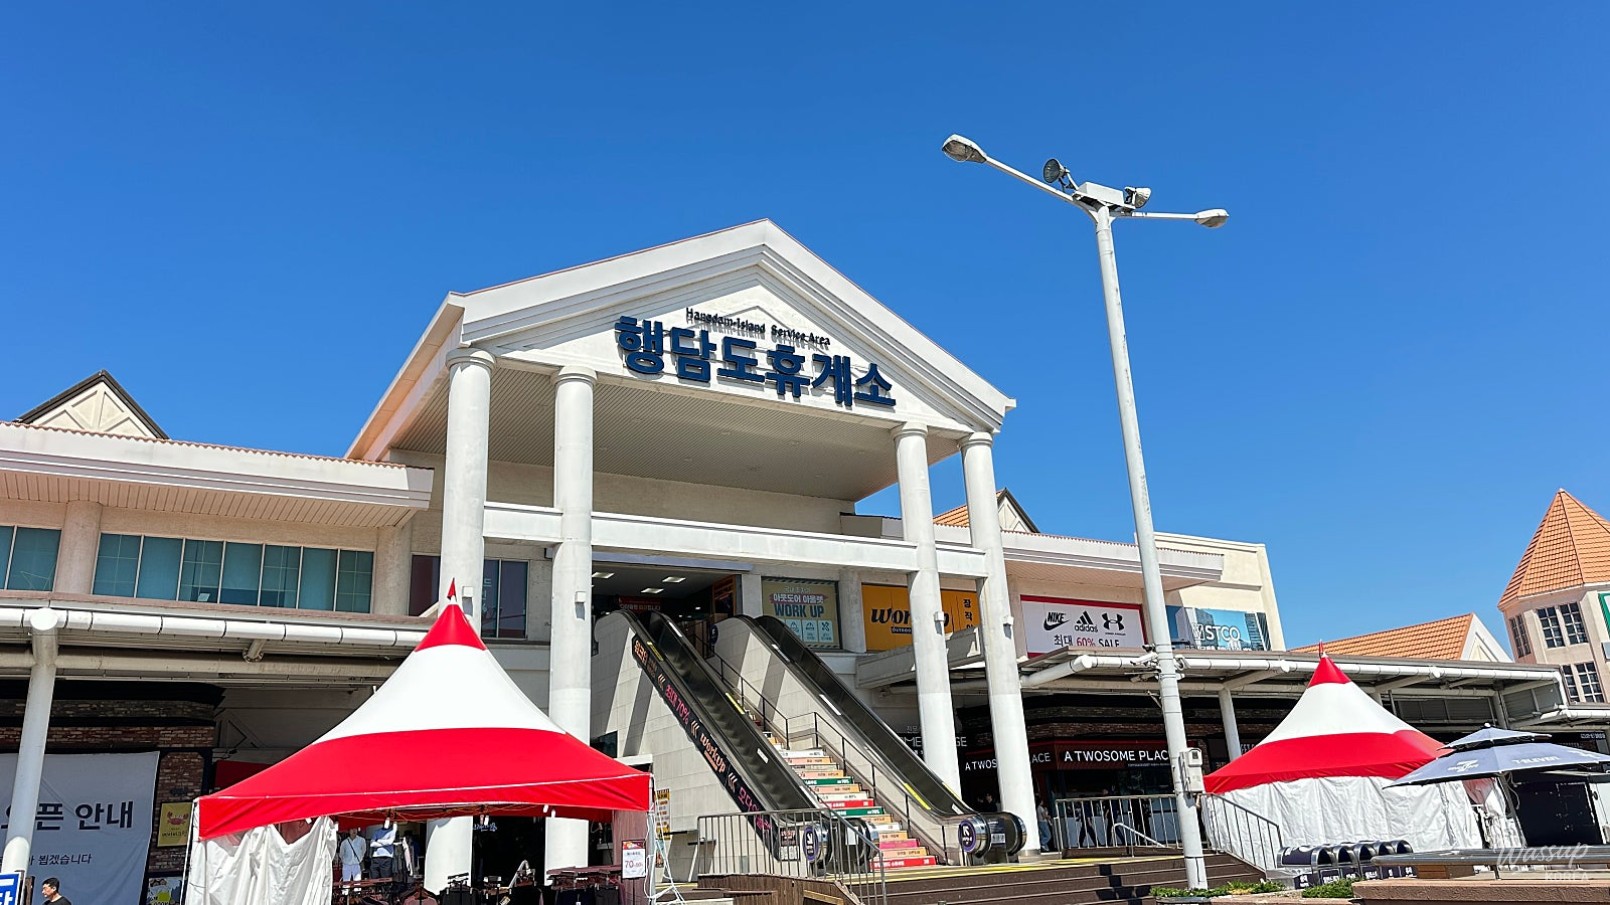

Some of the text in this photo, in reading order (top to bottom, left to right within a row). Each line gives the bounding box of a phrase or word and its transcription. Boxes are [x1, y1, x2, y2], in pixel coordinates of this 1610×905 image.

[771, 324, 806, 341] Service
[809, 332, 831, 346] Area
[614, 315, 896, 407] 행담도휴게소
[773, 593, 824, 604] 아웃도어 아울렛
[774, 604, 825, 617] WORK UP
[1047, 611, 1066, 623] NIKE
[1074, 625, 1098, 633] adidas
[1053, 634, 1073, 647] 최대
[1076, 636, 1095, 647] 60%
[700, 732, 726, 773] workup
[1064, 750, 1169, 762] A TWOSOME PLAC
[972, 759, 997, 770] TWOS
[1032, 752, 1050, 763] ACE
[75, 801, 134, 829] 안내
[38, 854, 92, 865] 뵙겠습니다
